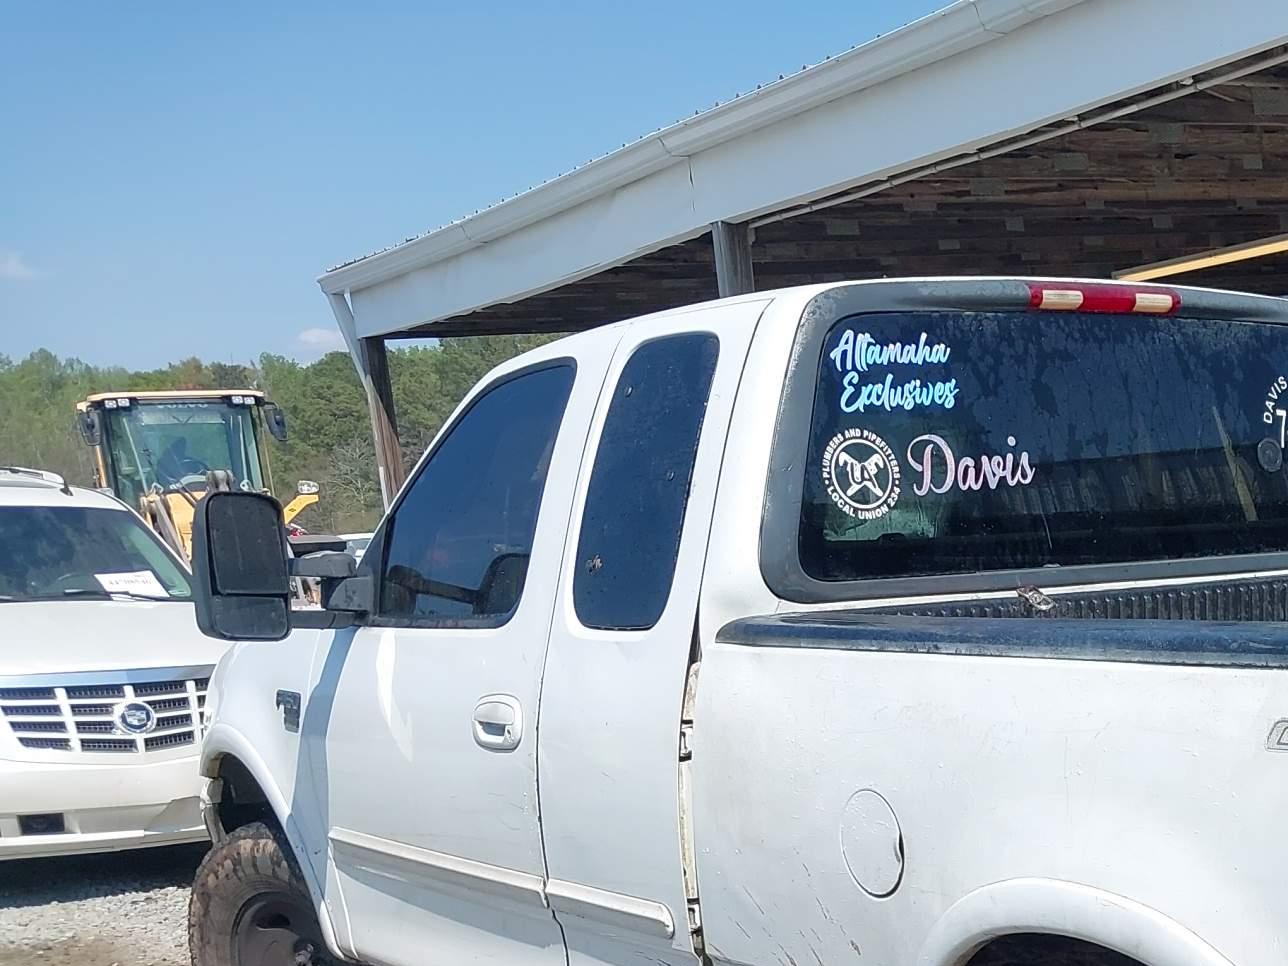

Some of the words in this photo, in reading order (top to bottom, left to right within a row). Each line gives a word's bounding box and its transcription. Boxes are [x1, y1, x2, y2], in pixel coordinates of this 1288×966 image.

[830, 329, 951, 371] Altamaha
[840, 371, 960, 413] Exclusives
[1263, 375, 1288, 424] DAVIS
[821, 432, 845, 479] PLUMBERS
[844, 428, 861, 439] AND
[863, 428, 901, 479] PIPEFITTERS
[907, 434, 1036, 496] Davis
[827, 485, 856, 518] LOCAL
[857, 504, 890, 520] UNION
[887, 486, 901, 508] 234
